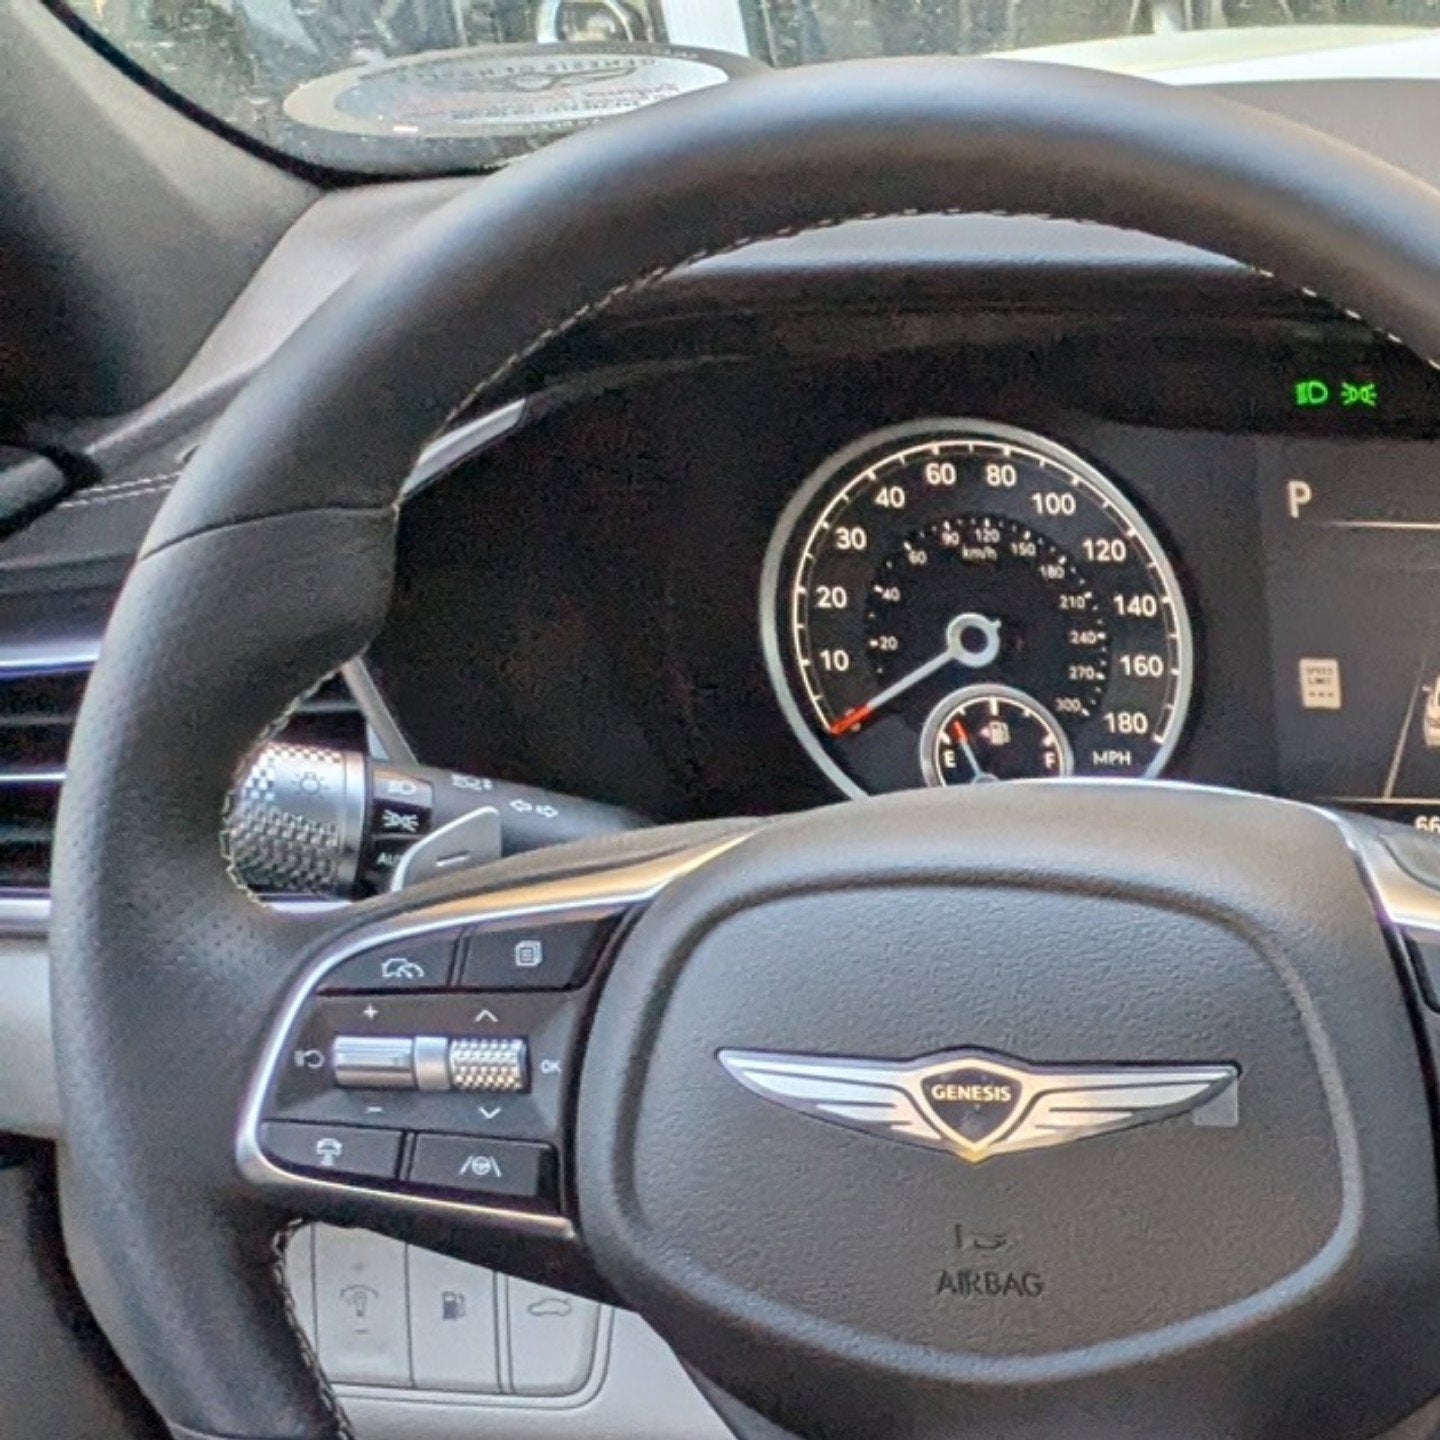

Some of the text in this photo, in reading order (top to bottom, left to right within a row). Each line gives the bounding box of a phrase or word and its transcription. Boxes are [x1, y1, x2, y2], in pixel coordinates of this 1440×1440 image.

[926, 463, 957, 486] 60
[986, 463, 1017, 487] 80
[875, 486, 906, 509] 40
[1031, 492, 1077, 516] 100
[1286, 480, 1313, 519] P
[835, 527, 867, 550] 30
[975, 528, 1000, 543] 120
[1082, 538, 1127, 562] 120
[816, 585, 848, 608] 20
[1113, 594, 1158, 617] 140
[819, 649, 850, 672] 10
[1120, 654, 1163, 677] 160
[1104, 712, 1148, 734] 180
[944, 750, 956, 768] E
[1044, 751, 1056, 769] F
[1092, 749, 1131, 767] MPH
[930, 1083, 1013, 1103] GENESIS
[936, 1270, 1045, 1299] AIRBAG
